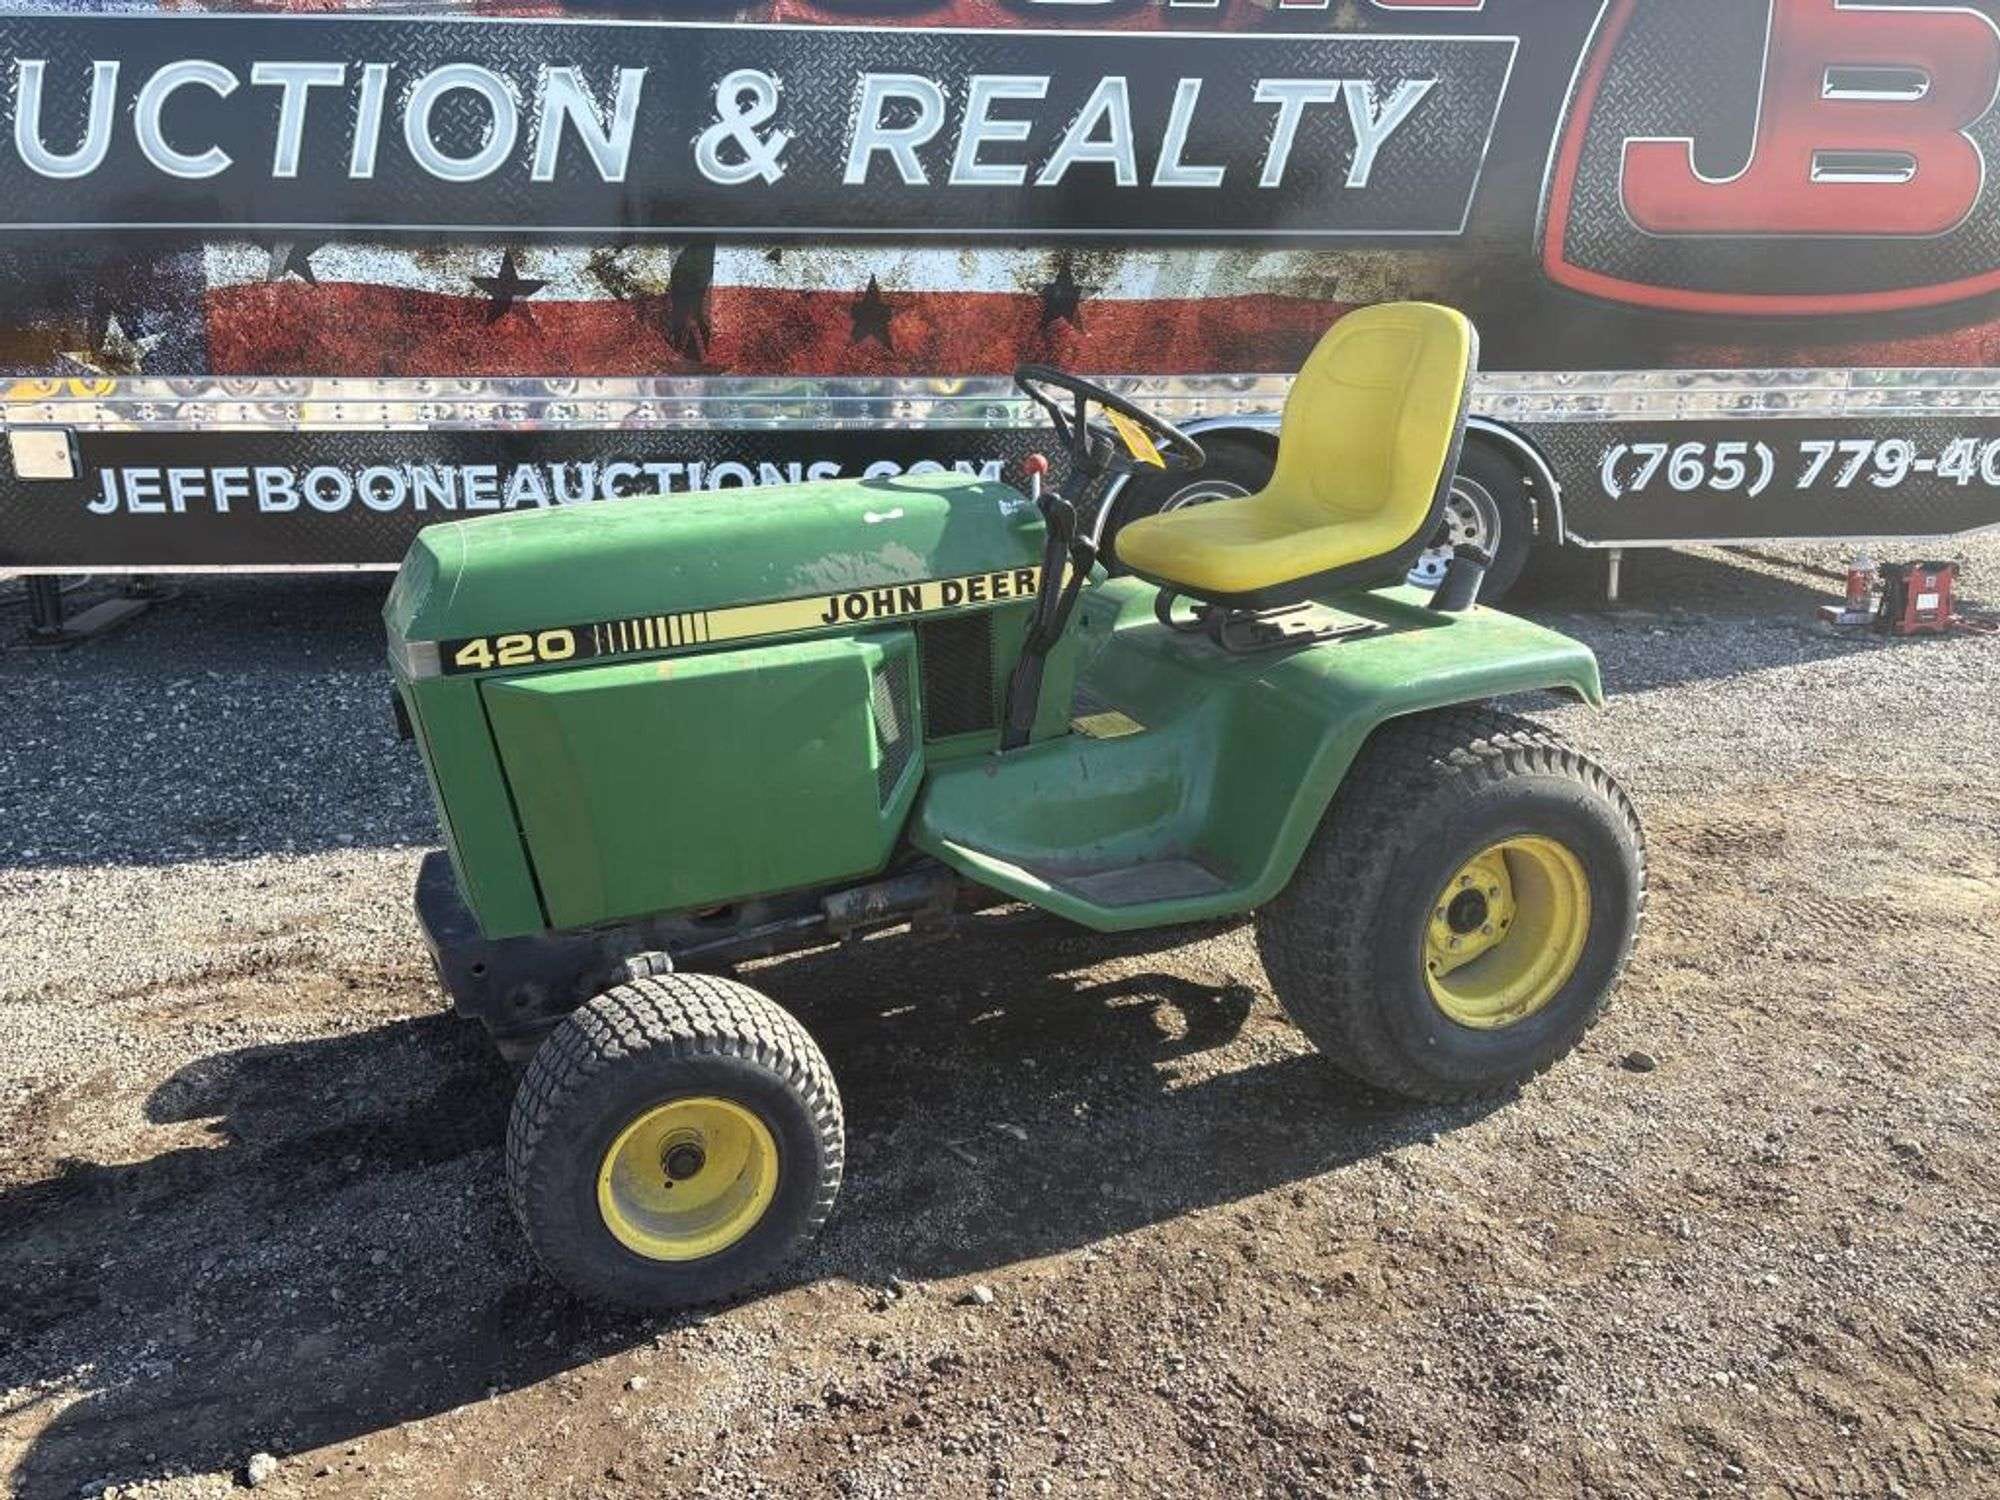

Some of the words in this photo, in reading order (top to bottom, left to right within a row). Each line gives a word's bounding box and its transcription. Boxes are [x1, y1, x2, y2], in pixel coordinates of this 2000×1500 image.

[13, 59, 646, 183] UCTION
[693, 68, 797, 186] &
[846, 72, 1438, 188] REALTY
[87, 461, 1004, 514] JEFFBOONEAUCTION
[1601, 441, 1774, 499] (765)
[821, 586, 922, 626] JOHN
[941, 567, 1035, 606] DEER
[455, 629, 576, 669] 420
